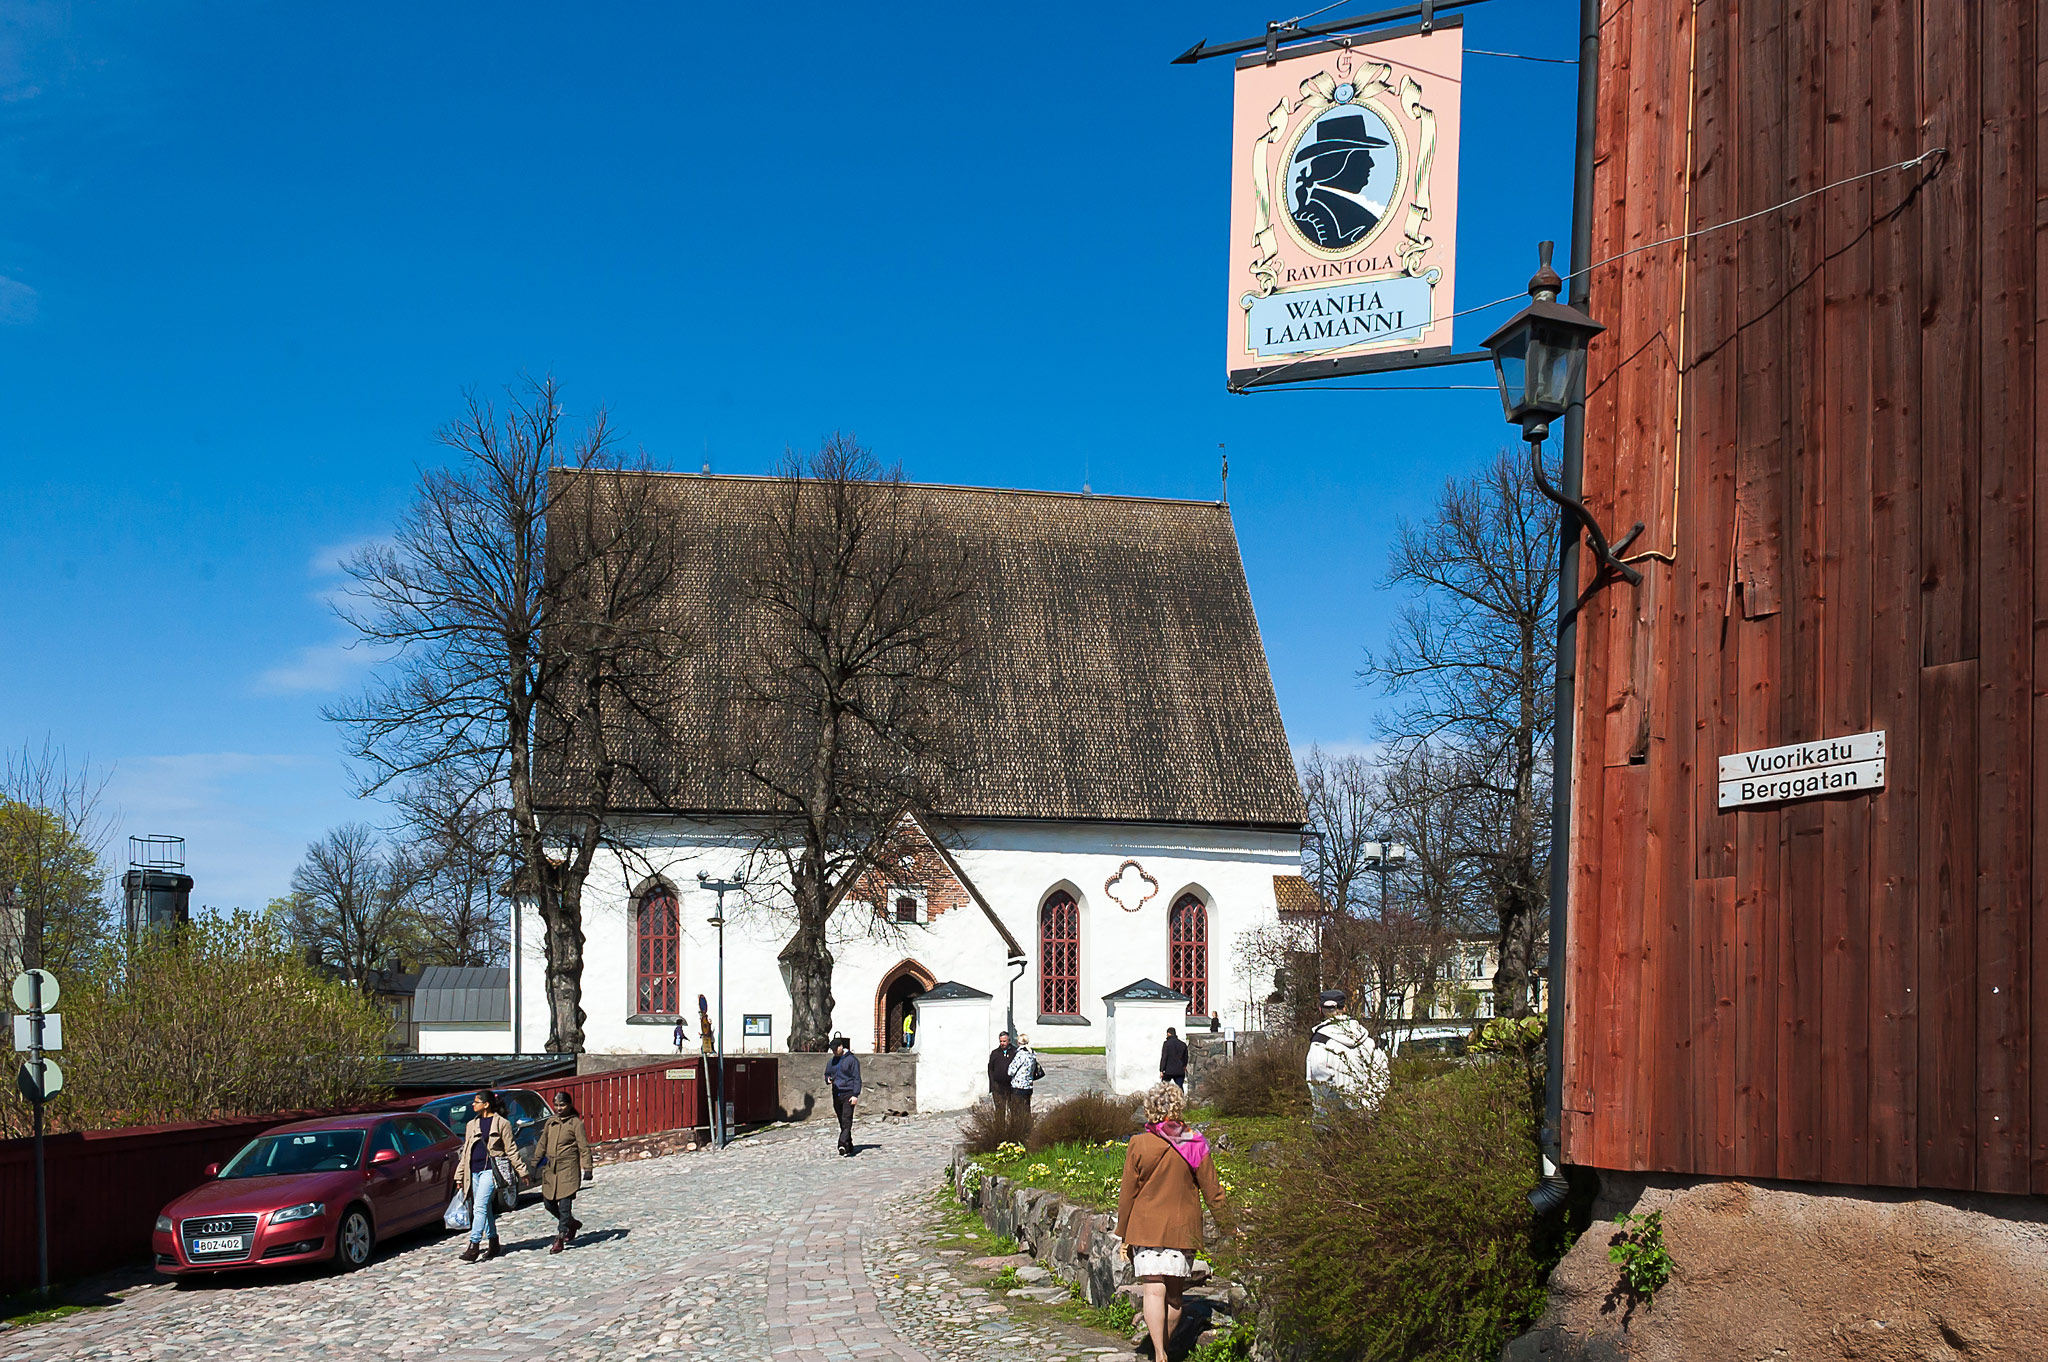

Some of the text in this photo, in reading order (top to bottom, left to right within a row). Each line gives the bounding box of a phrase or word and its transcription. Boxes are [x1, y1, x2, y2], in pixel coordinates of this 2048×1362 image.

[1286, 256, 1394, 282] RAVINTOLA
[1285, 290, 1384, 320] WANHA
[1265, 311, 1405, 346] LAAMANNI
[1746, 742, 1853, 773] Vuorikatu
[1741, 770, 1858, 800] Berggatan
